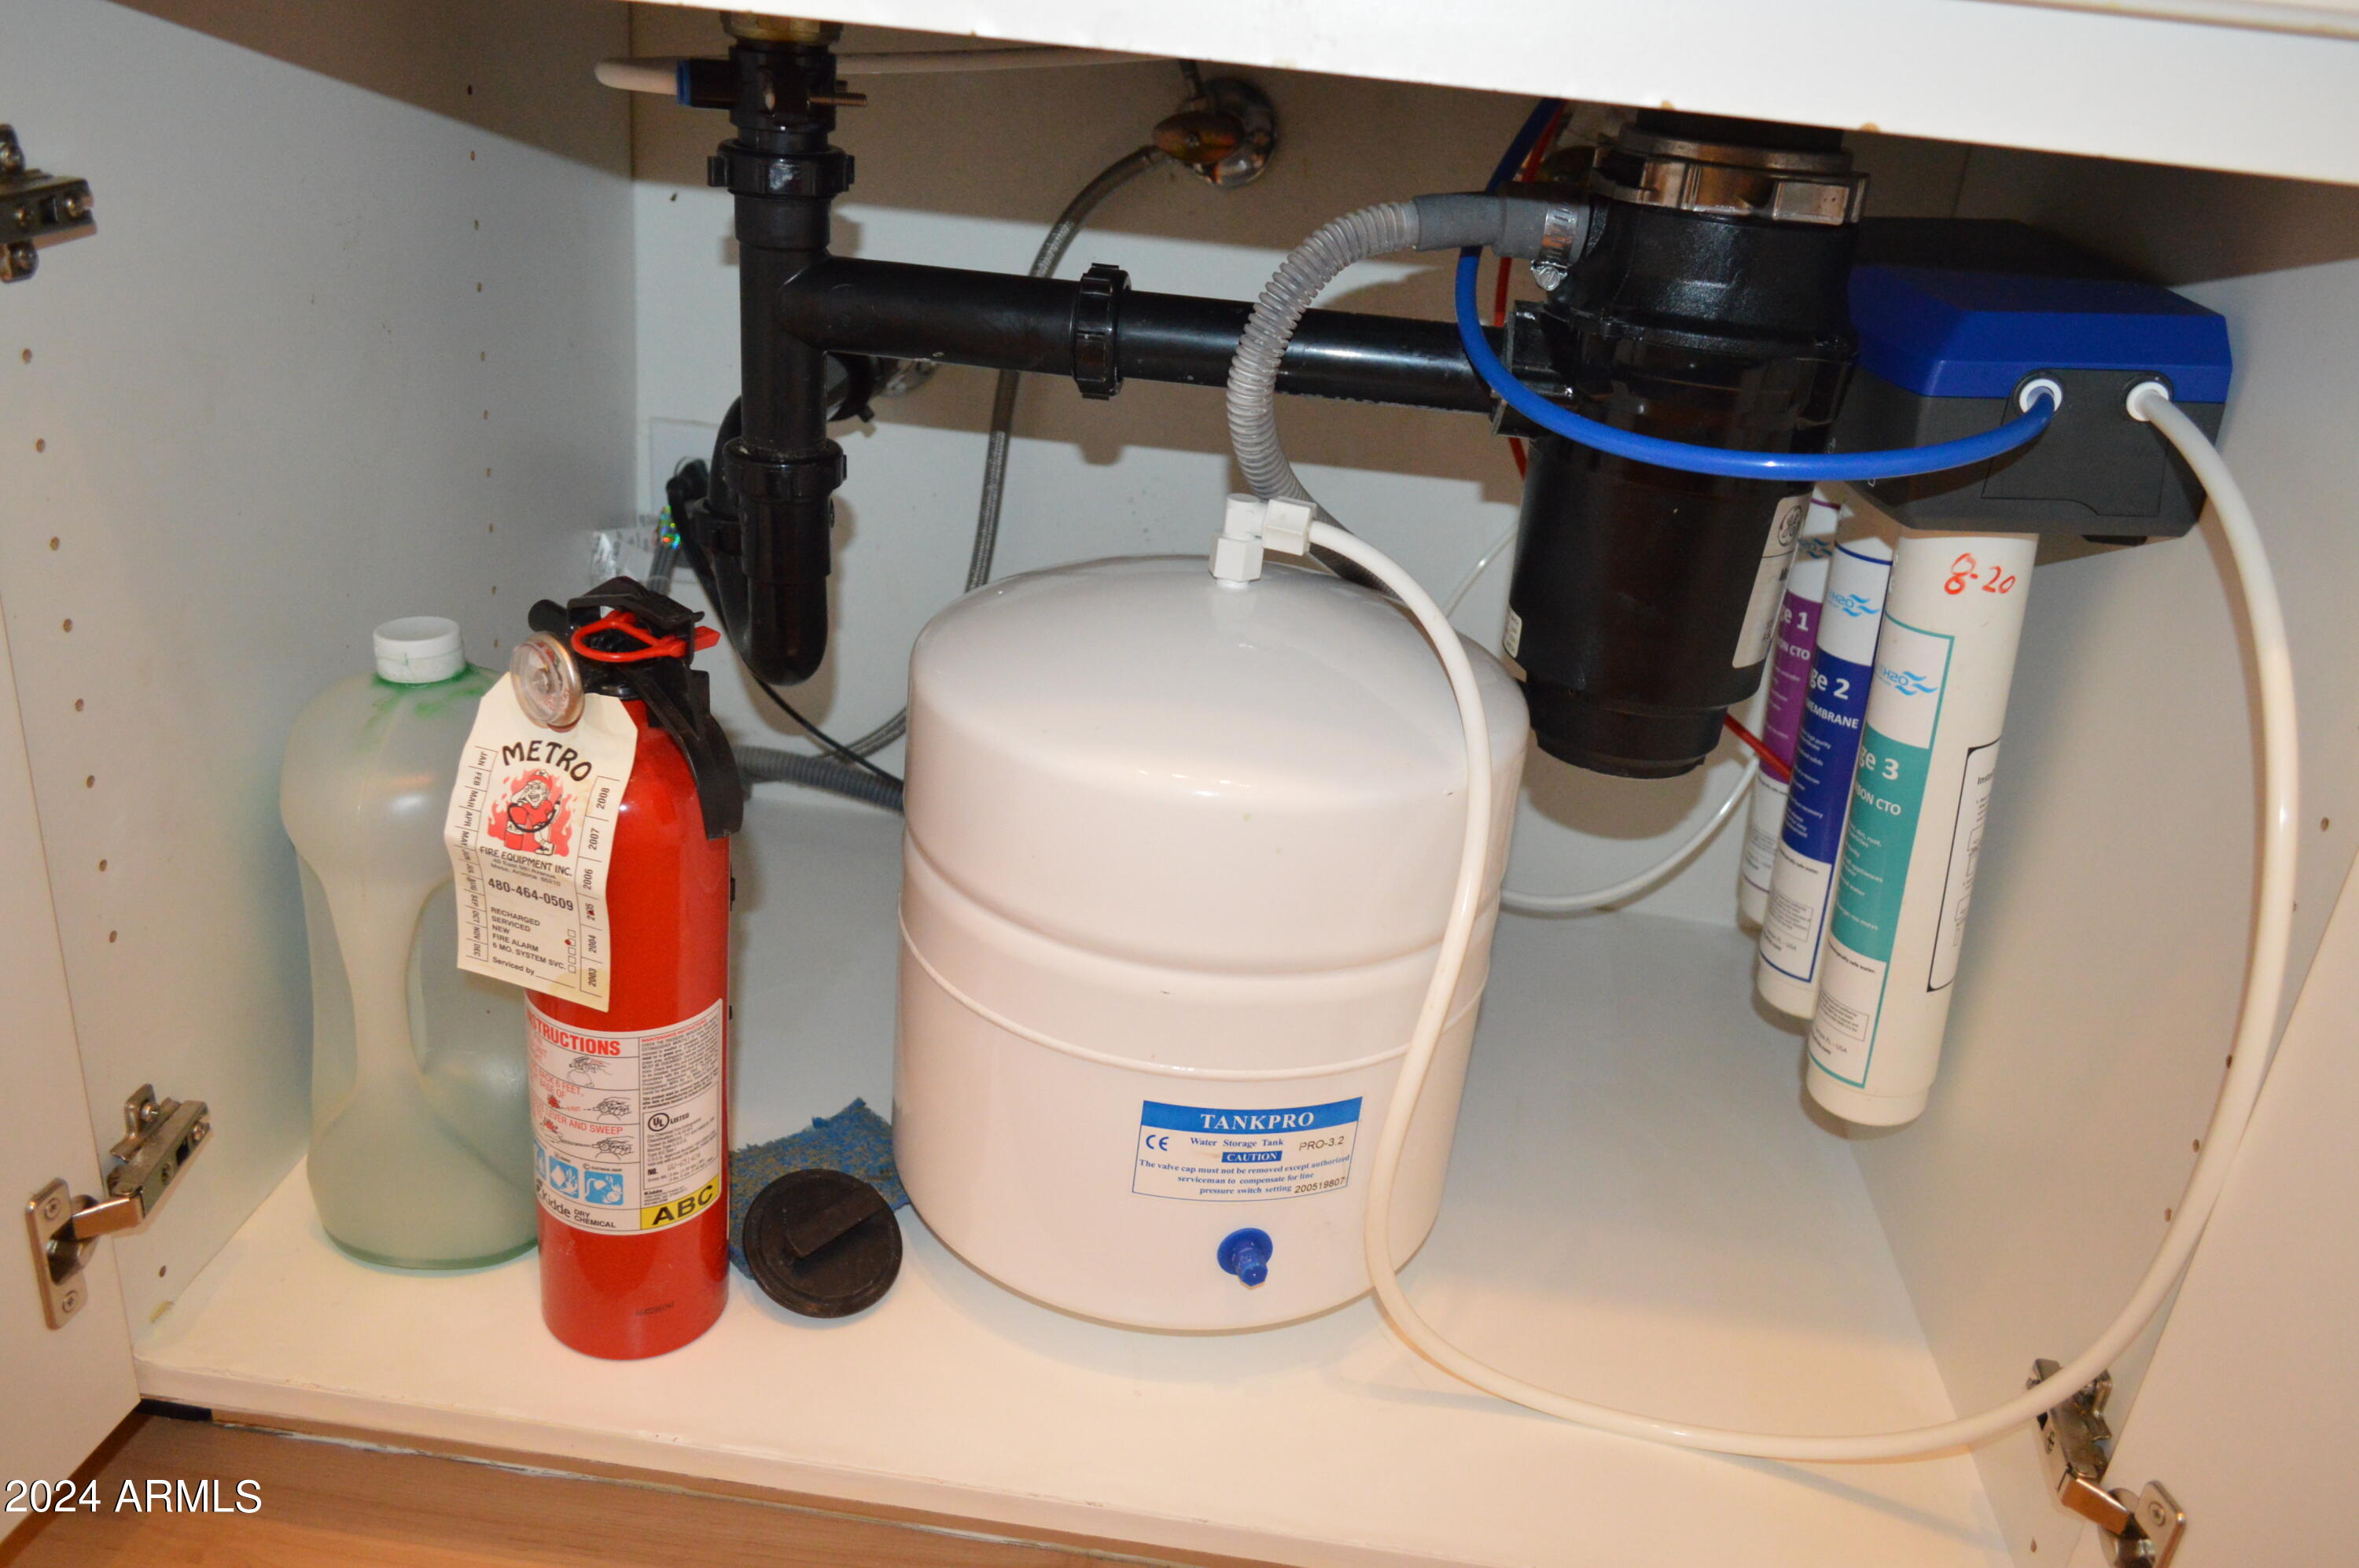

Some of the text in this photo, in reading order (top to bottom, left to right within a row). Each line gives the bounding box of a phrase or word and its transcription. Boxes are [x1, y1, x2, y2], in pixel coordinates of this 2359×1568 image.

[1944, 552, 2016, 595] 8-20
[1797, 611, 1809, 631] 1
[1790, 645, 1810, 661] CTO
[1833, 678, 1850, 700] 2
[478, 751, 488, 767] JAN
[502, 740, 592, 782] METRO
[473, 771, 482, 786] FEB
[1882, 758, 1900, 781] 3
[467, 790, 478, 808] MAR
[596, 787, 610, 810] 2008
[1875, 798, 1901, 815] CTO
[464, 811, 473, 827] APR
[461, 830, 469, 847] MAY
[587, 828, 600, 851] 2007
[480, 846, 573, 878] FIRE EQUIPMENT INC.
[583, 868, 594, 890] 2006
[488, 878, 574, 911] 480-464-0509
[491, 907, 540, 926] RECHARGED
[491, 915, 532, 932] SERVICED
[491, 924, 510, 934] NEW
[492, 933, 539, 952] FIRE ALARM
[588, 934, 597, 953] 2004
[492, 956, 535, 976] Serviced by
[499, 944, 514, 954] MO.
[515, 948, 547, 963] SYSTEM
[548, 959, 566, 970] SVC.
[587, 967, 597, 987] 2003
[569, 1120, 587, 1131] AND
[590, 1124, 624, 1135] SWEEP
[653, 1117, 665, 1128] UL
[670, 1113, 690, 1124] LISTED
[1200, 1112, 1315, 1130] TANKPRO
[1190, 1137, 1218, 1147] Water
[1223, 1139, 1257, 1148] Storage
[1299, 1136, 1345, 1150] PRO-3.2
[1139, 1159, 1156, 1168] The
[1157, 1162, 1180, 1172] valve
[1248, 1165, 1283, 1174] removed
[1285, 1163, 1309, 1172] except
[1311, 1154, 1350, 1168] authorized
[1227, 1152, 1278, 1161] CAUTION
[1177, 1176, 1226, 1184] serviceman
[1239, 1176, 1286, 1185] compensate
[1237, 1186, 1262, 1194] switch
[1264, 1184, 1292, 1193] setting
[1294, 1176, 1346, 1194] 200519807
[574, 1209, 591, 1218] DRY
[652, 1184, 713, 1226] ABC
[574, 1215, 617, 1228] CHEMICAL
